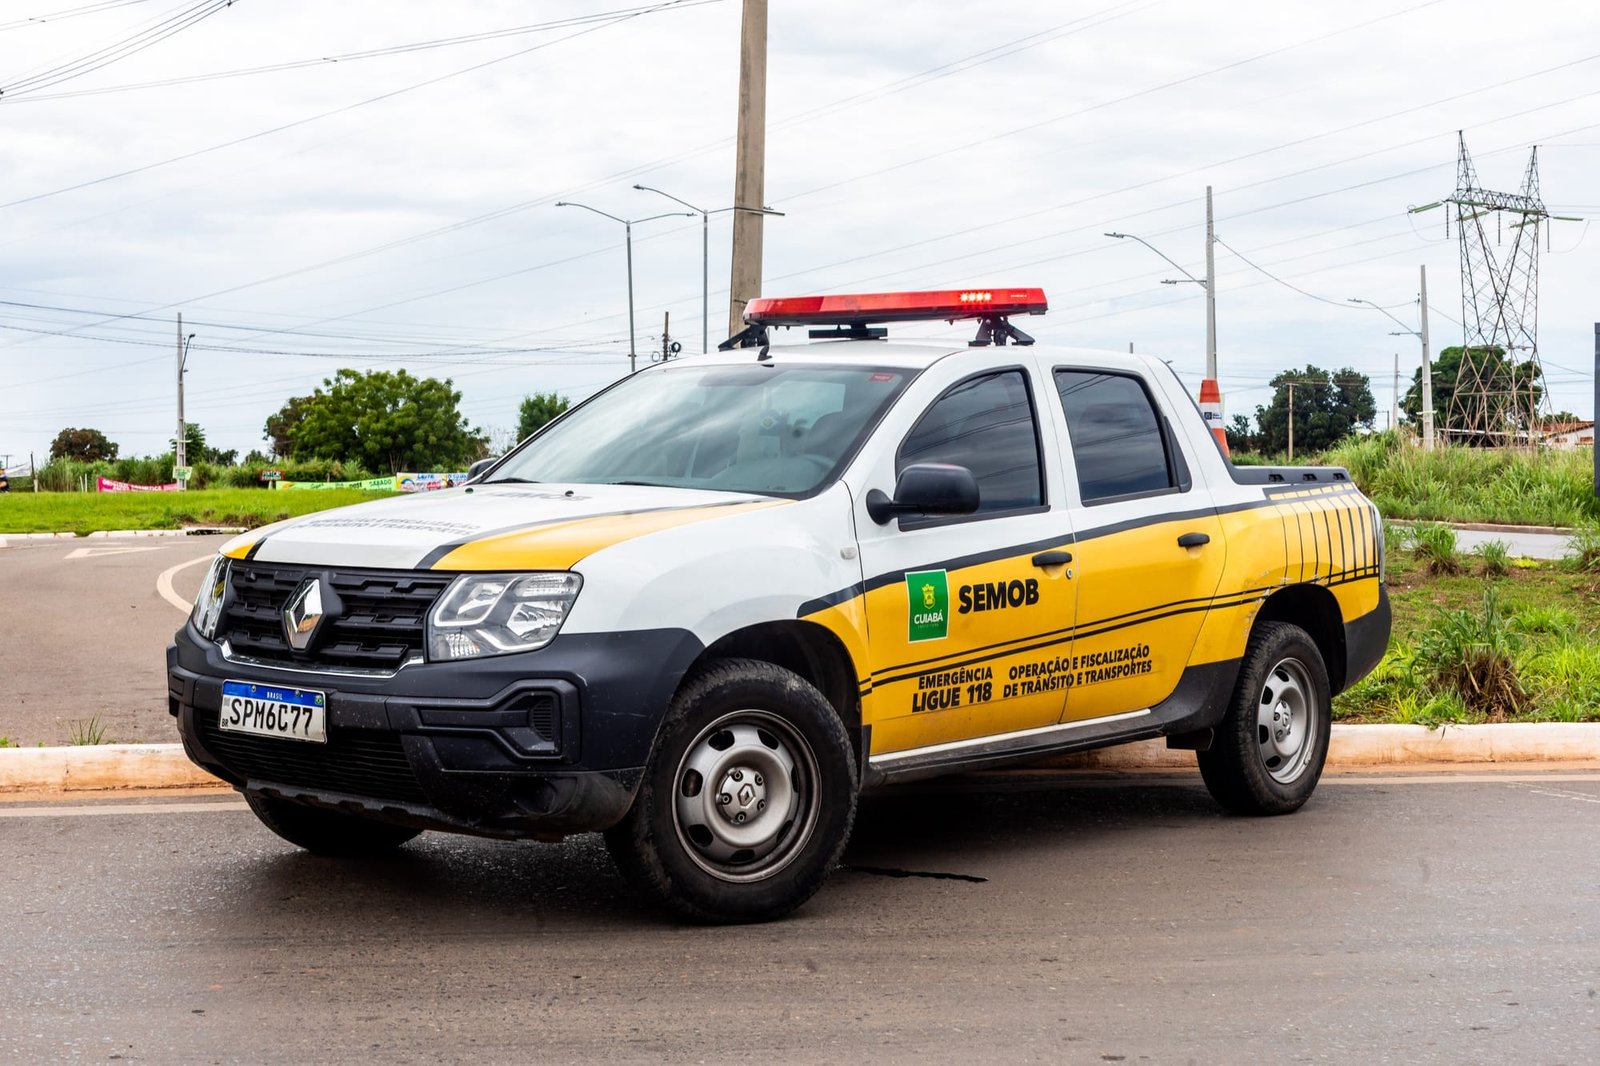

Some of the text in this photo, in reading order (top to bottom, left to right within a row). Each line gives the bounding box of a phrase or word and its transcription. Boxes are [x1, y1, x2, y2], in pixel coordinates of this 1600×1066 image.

[958, 579, 1040, 614] SEMOB
[914, 609, 943, 624] CUIABÁ
[918, 666, 993, 690] EMERGÊNCIA
[1009, 643, 1150, 680] OPERAÇÃO E FISCALIZAÇÃO
[1003, 660, 1152, 698] DE TRÂNSITO E TRANSPORTES
[266, 691, 283, 701] BRASIL
[912, 682, 993, 713] LIGUE 118
[229, 698, 313, 736] SPM6C77
